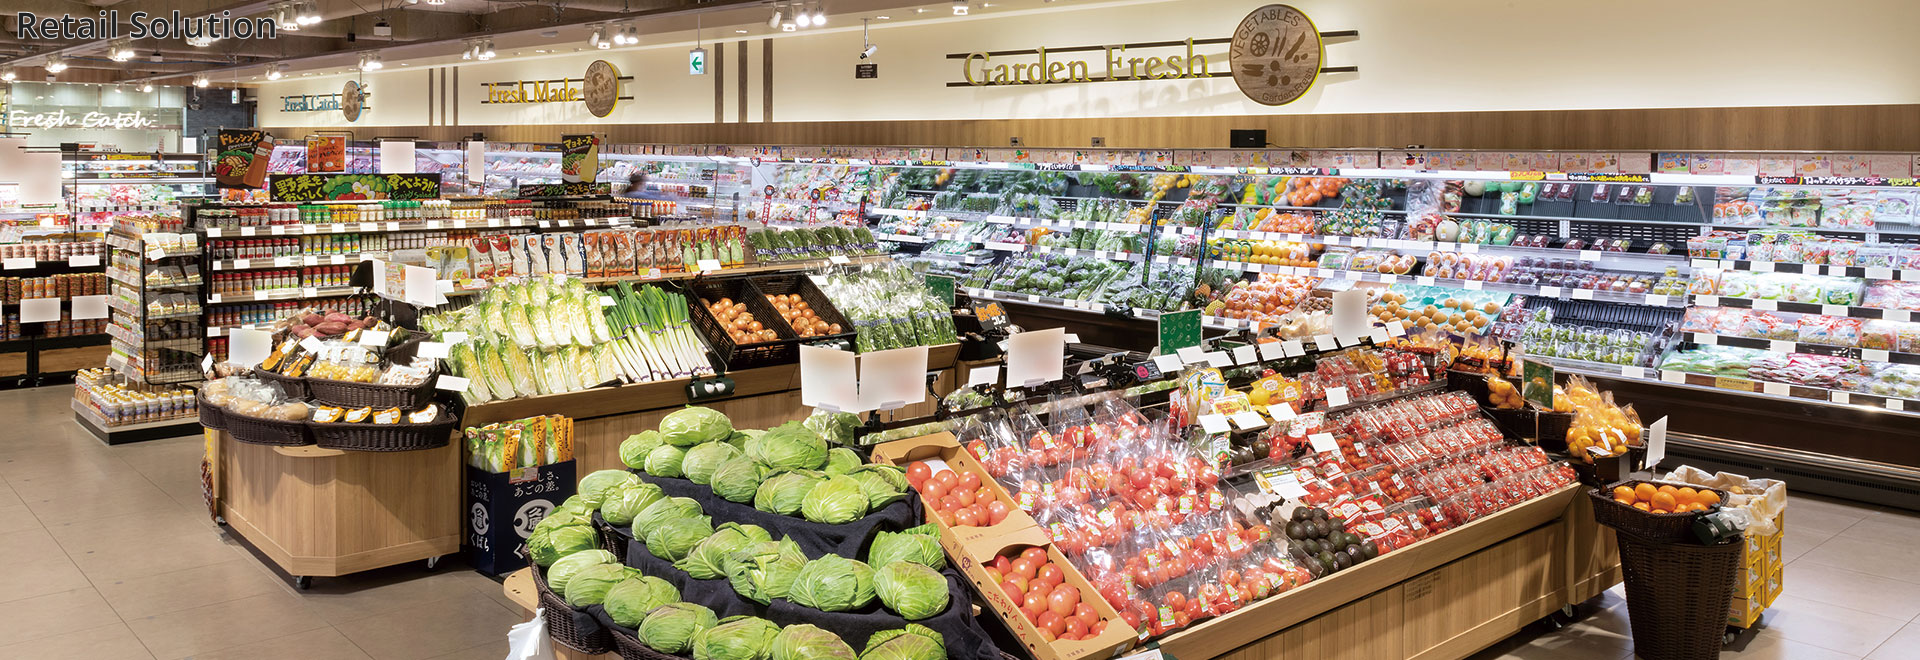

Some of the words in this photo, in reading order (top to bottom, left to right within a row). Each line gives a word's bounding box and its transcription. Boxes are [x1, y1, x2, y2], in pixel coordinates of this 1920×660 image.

[1233, 9, 1301, 60] VEGETABLES
[963, 46, 1092, 86] Garden
[1102, 37, 1213, 82] Fresh
[488, 79, 529, 104] Fresh
[533, 77, 579, 103] Made
[1262, 87, 1295, 102] Garden
[1294, 67, 1314, 93] Fresh
[284, 93, 309, 112] Fresh
[311, 92, 339, 111] Catch
[9, 109, 77, 129] Fresh
[82, 110, 151, 129] Catch
[274, 175, 323, 197] 野菜を
[283, 186, 323, 202] おいしく
[514, 480, 560, 498] あごの差。
[471, 533, 490, 552] くばら
[987, 591, 1027, 641] こだわりトマト
